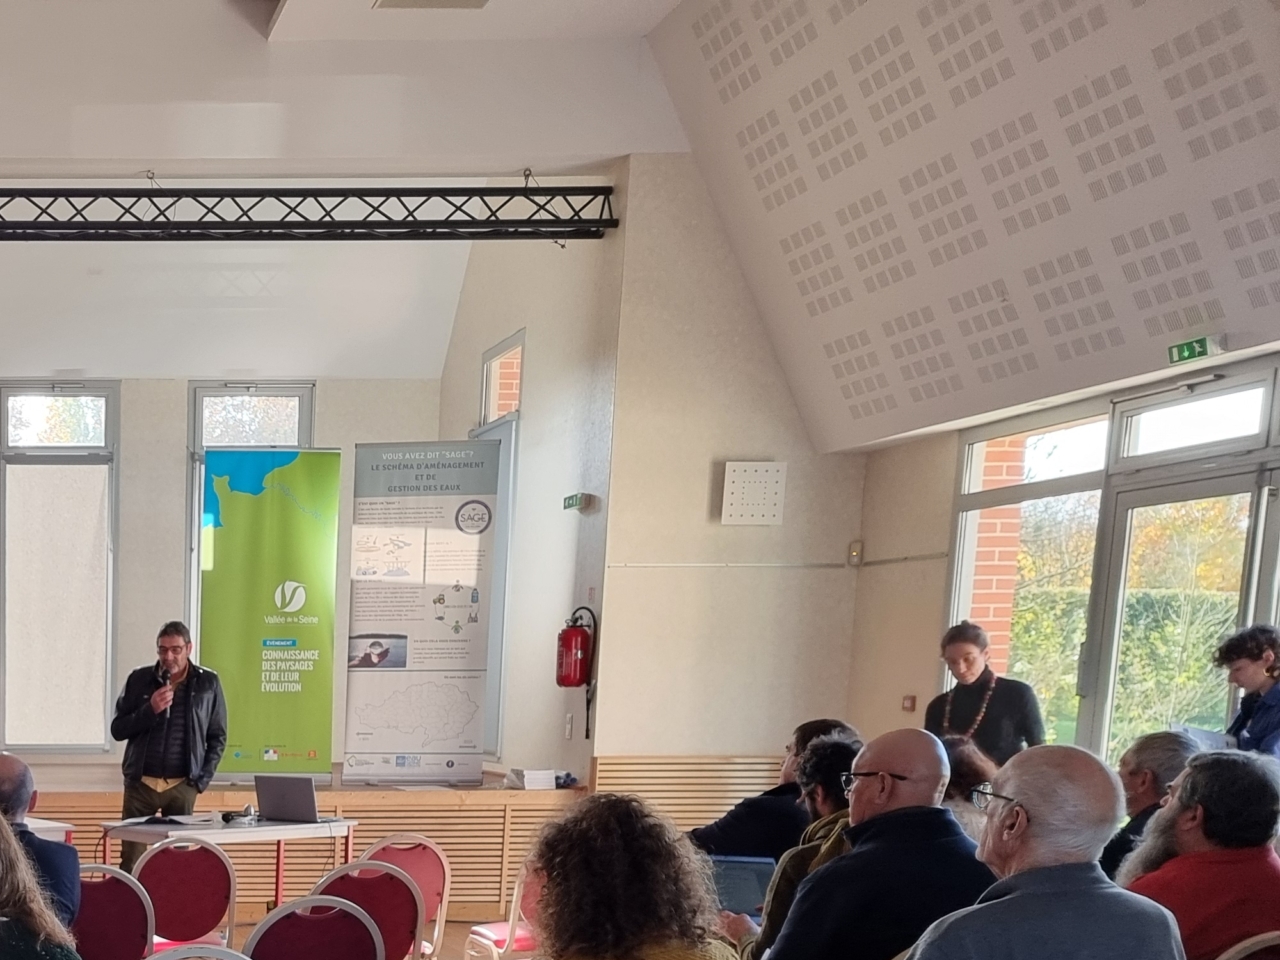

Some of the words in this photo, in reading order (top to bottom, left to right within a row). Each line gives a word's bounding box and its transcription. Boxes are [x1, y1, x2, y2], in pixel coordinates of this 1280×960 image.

[404, 452, 425, 460] AVEZ
[427, 451, 440, 459] DIT
[382, 462, 415, 471] SCHÉMA
[416, 461, 485, 470] D'AMÉNAGEMENT
[423, 484, 438, 492] DES
[460, 513, 487, 523] SAGE
[264, 615, 286, 624] Vallée
[298, 615, 319, 624] Seine
[262, 650, 319, 660] CONNAISSANCE
[262, 661, 276, 671] DES
[277, 661, 314, 671] PAYSAGES
[261, 672, 270, 681] ET
[270, 672, 280, 681] DE
[281, 672, 299, 681] LEUR
[261, 679, 302, 692] ÉVOLUTION
